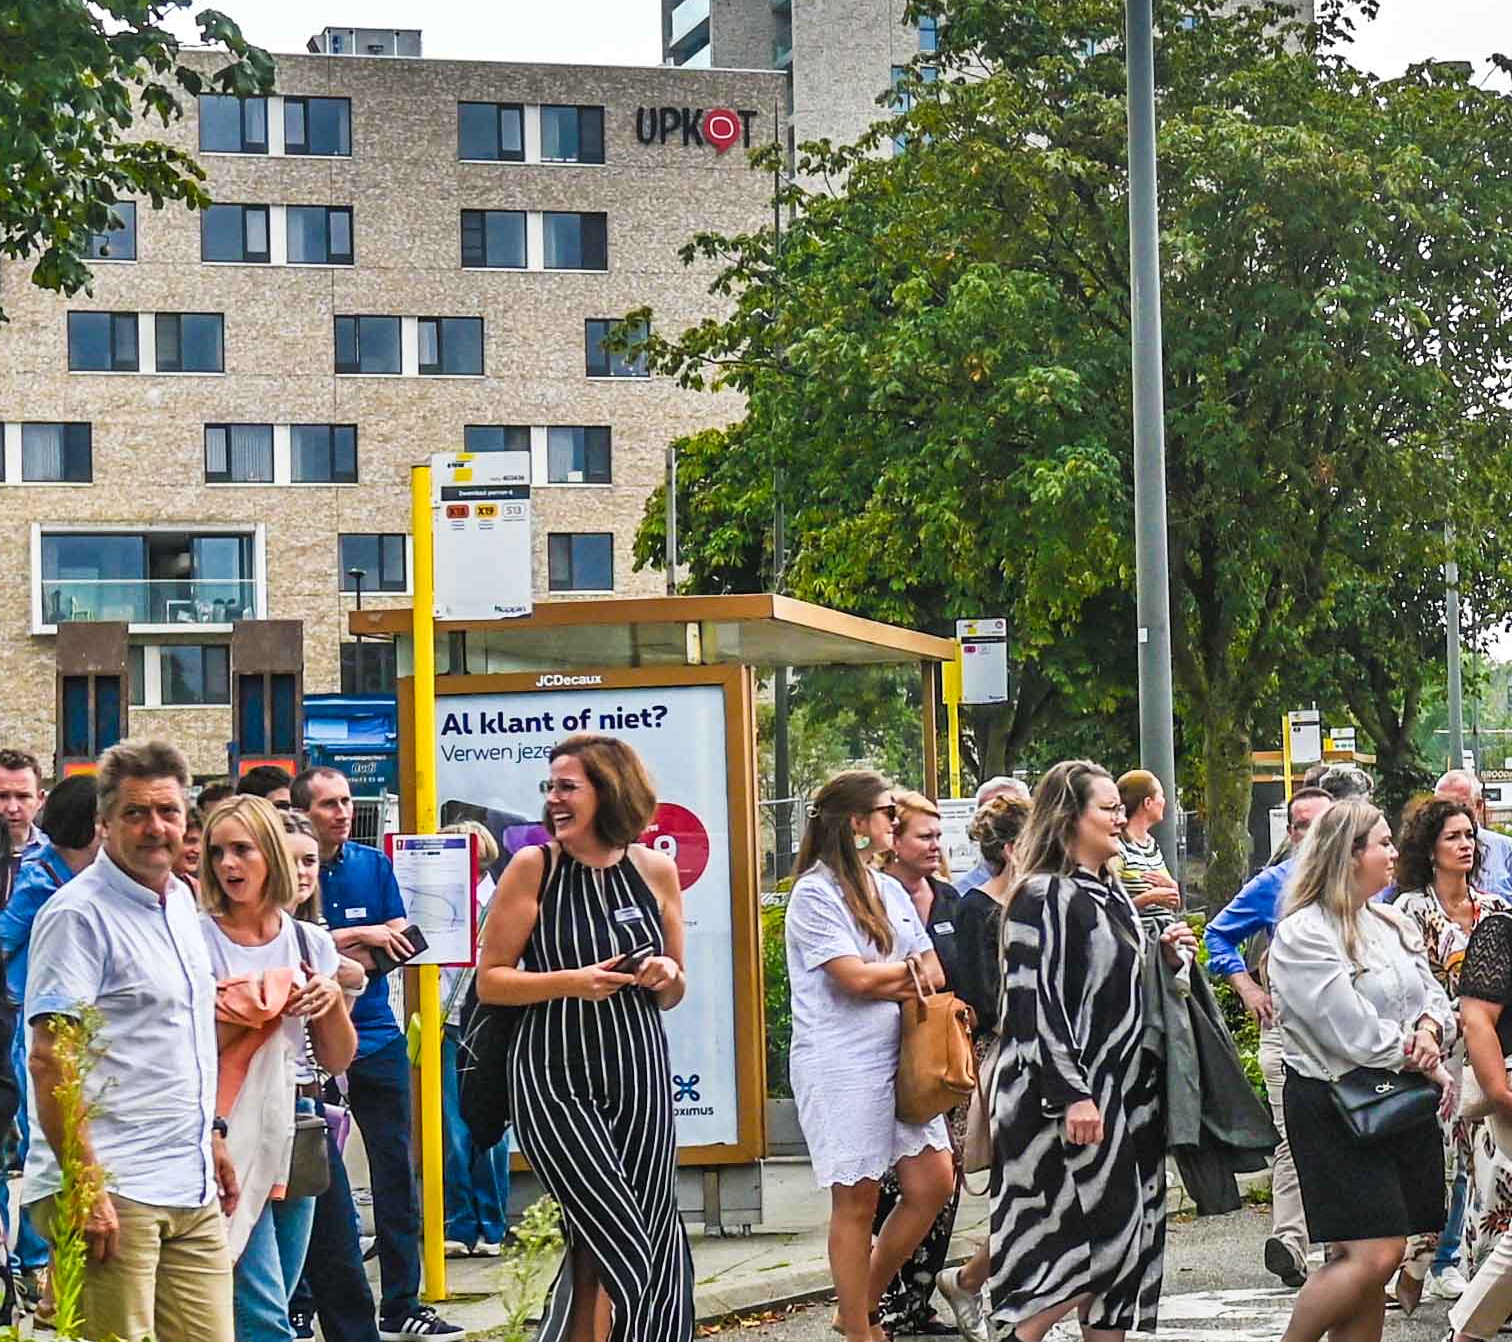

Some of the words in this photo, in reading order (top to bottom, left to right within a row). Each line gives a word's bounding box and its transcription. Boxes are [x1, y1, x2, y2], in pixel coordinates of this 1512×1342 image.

[637, 105, 758, 149] UPKOT
[478, 506, 494, 516] X19
[536, 674, 603, 687] JCDecaux
[441, 712, 472, 736] Al
[481, 712, 555, 735] klant
[562, 708, 592, 731] of
[600, 705, 668, 730] niet?
[441, 743, 513, 762] Verwen
